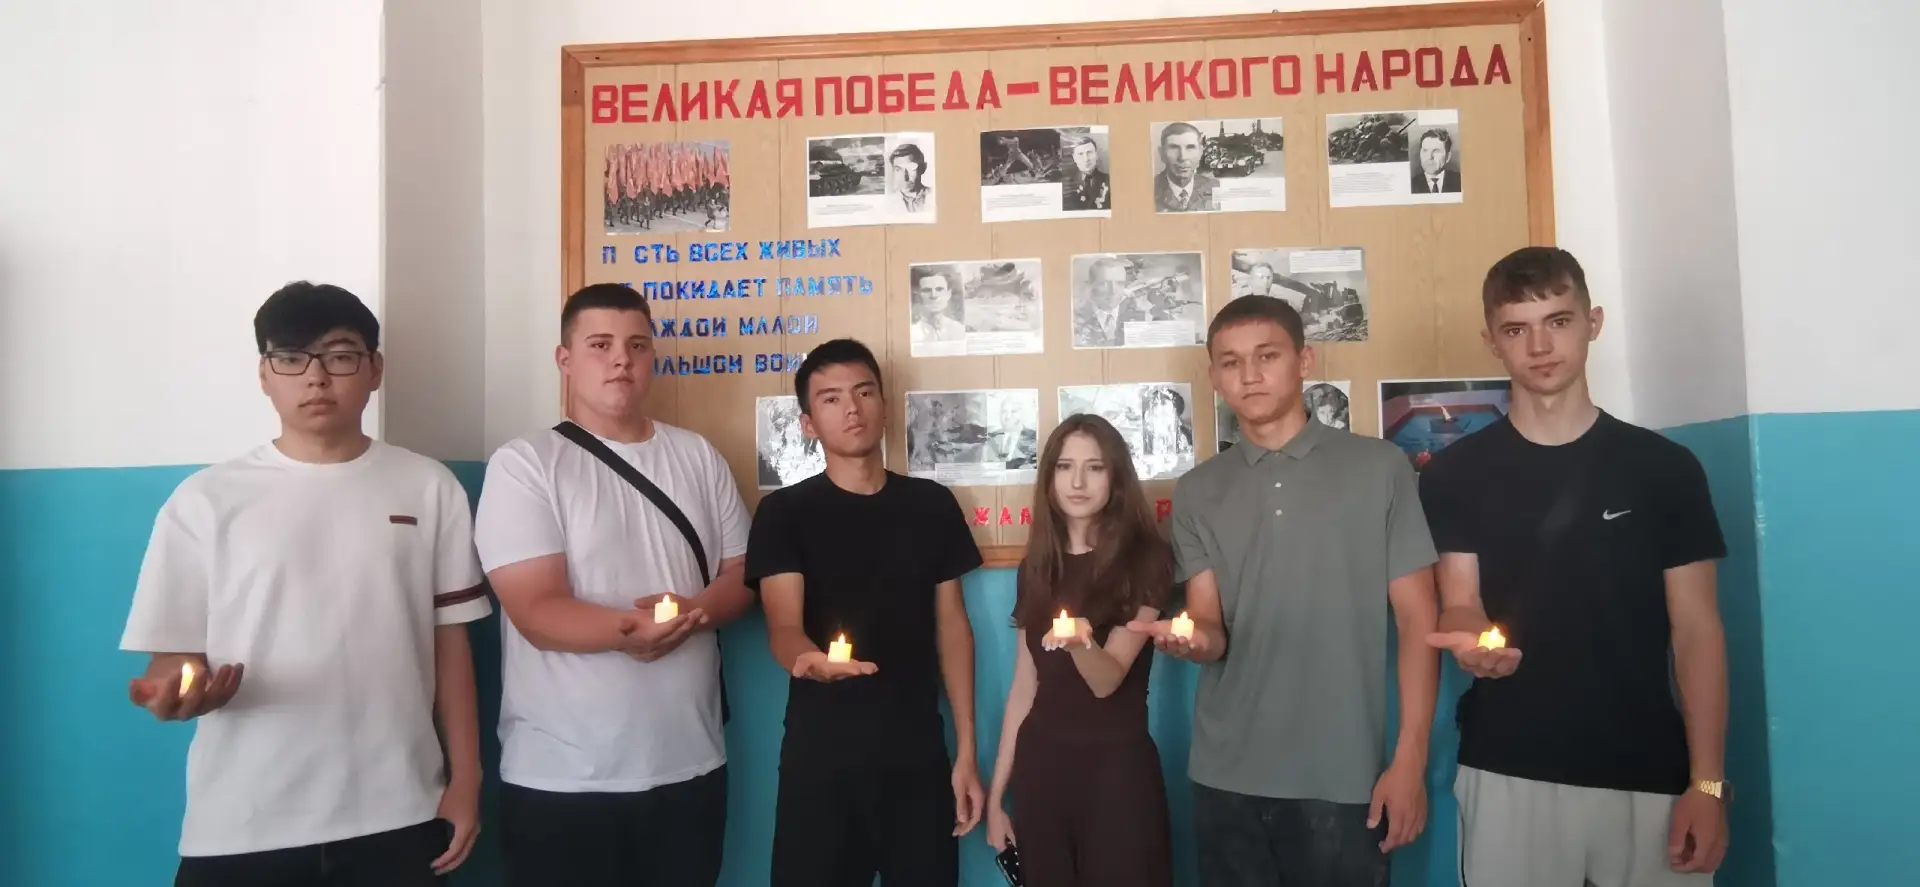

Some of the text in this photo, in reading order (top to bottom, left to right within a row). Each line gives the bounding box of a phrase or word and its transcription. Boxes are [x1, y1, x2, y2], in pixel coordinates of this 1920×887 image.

[591, 78, 804, 125] ВЕЛИКАЯ
[814, 71, 1002, 117] ПОБЕДА
[1049, 54, 1302, 105] ВЕЛИКОГО
[1314, 43, 1513, 93] НАРОДА
[689, 241, 749, 262] ВСЕХ
[758, 238, 842, 261] ЖИВЫХ
[643, 275, 767, 300] ПОКИДАЕТ
[776, 274, 873, 297] ПАМЯТЬ
